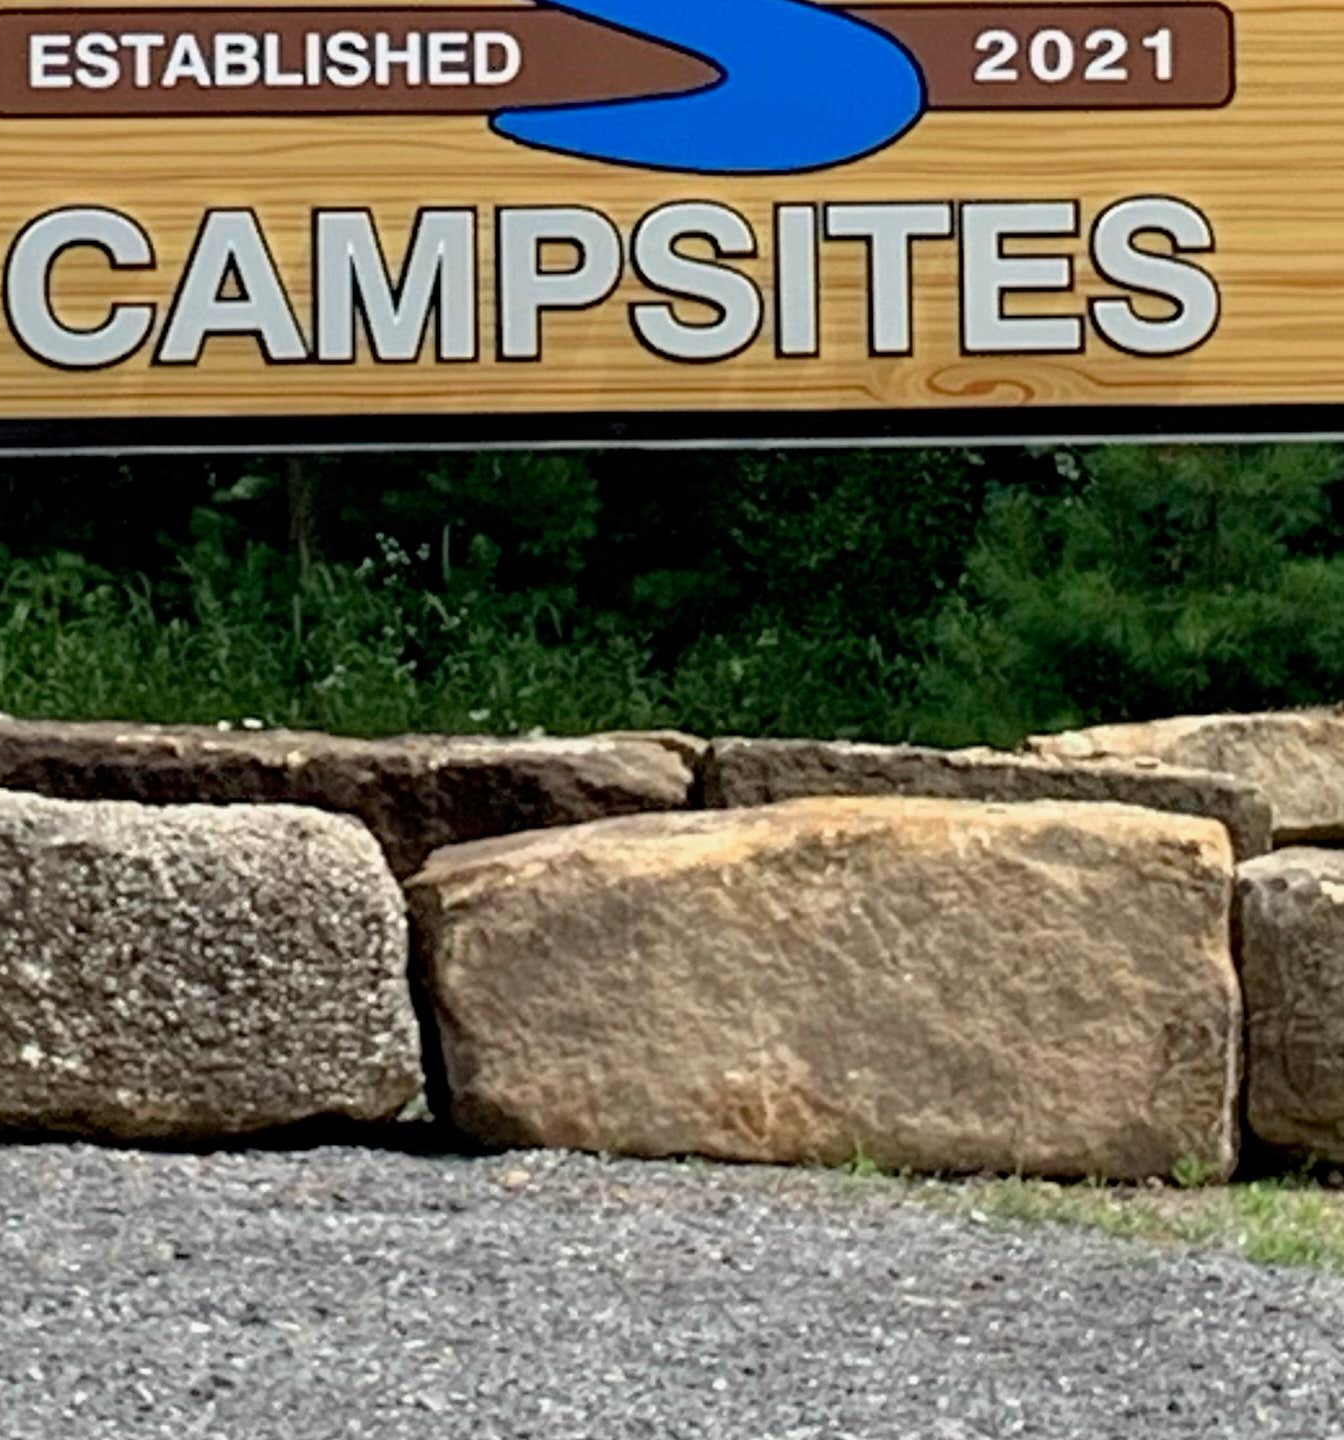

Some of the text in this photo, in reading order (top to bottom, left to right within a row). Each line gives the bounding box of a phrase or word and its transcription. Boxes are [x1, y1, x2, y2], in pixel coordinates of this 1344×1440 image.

[28, 29, 1177, 91] ESTABLISHED 2021
[2, 196, 1220, 370] CAMPSITES
